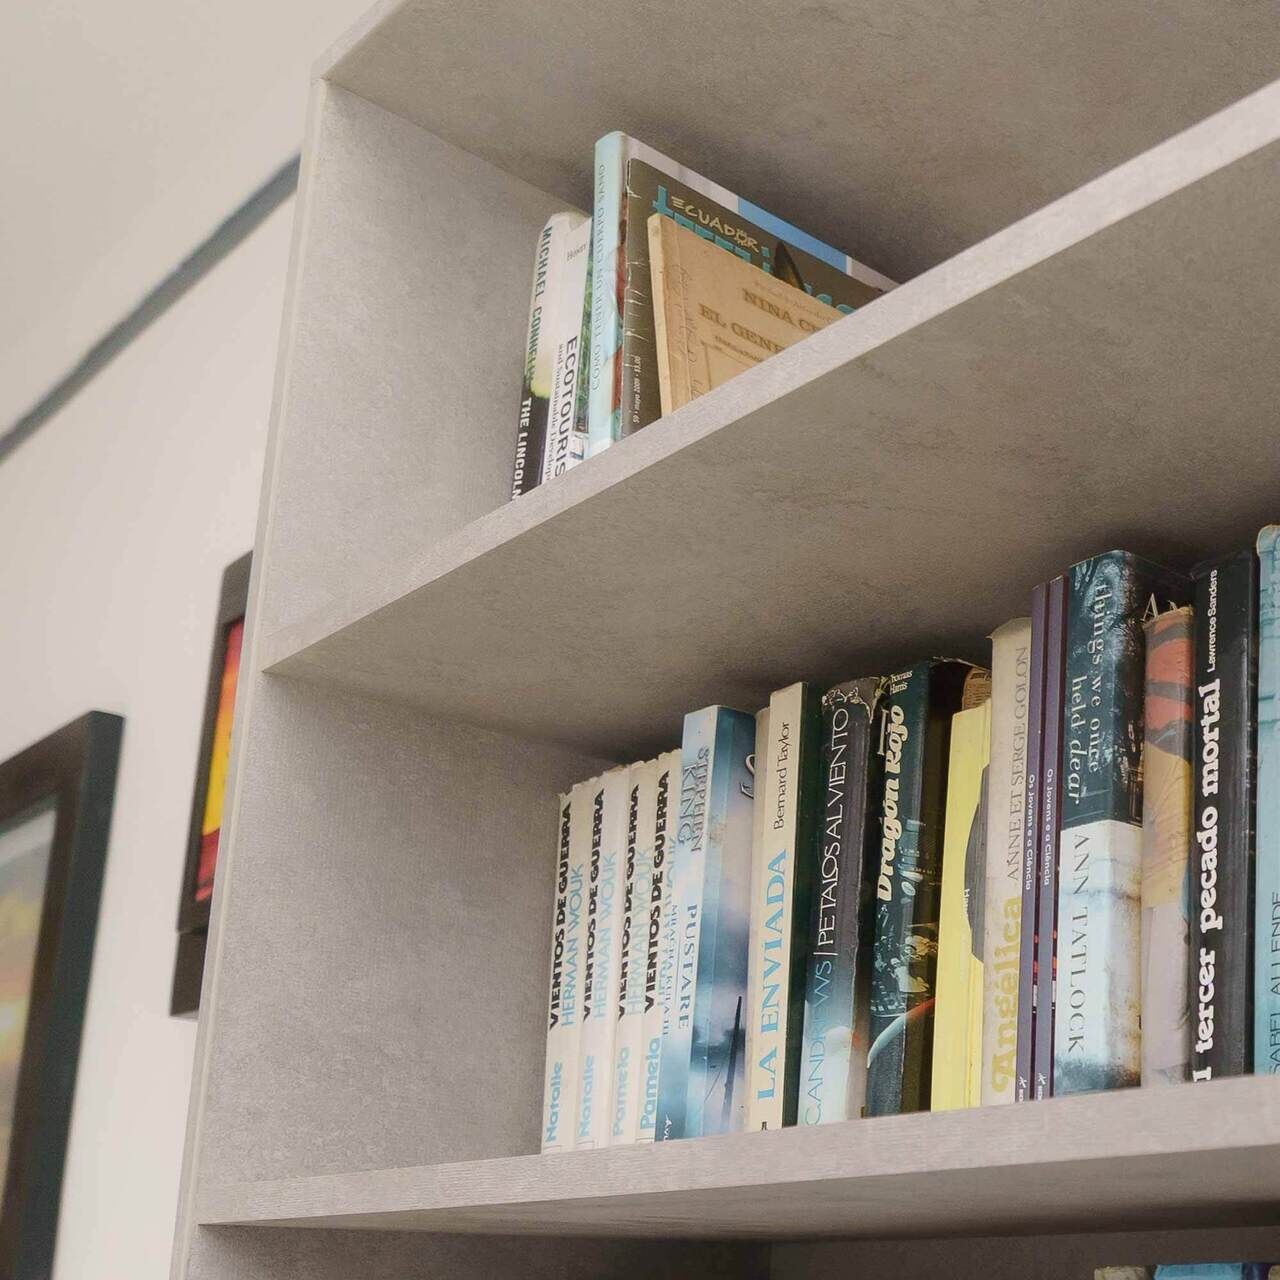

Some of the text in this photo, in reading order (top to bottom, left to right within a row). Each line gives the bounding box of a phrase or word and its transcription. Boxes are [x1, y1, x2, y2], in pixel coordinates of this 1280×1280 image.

[518, 398, 532, 430] THE
[1011, 722, 1025, 787] SERGE
[1070, 676, 1088, 729] held
[1089, 675, 1103, 773] we once
[556, 802, 571, 926] DE GUERRA
[1009, 791, 1022, 816] ET
[1195, 569, 1224, 1054] tercer pecado mortal Lawrence Sanders
[583, 788, 605, 1023] VIENTOS DE GUERRA
[617, 784, 640, 1023] VIENTOS DE GUERRA
[645, 770, 670, 1014] VIENTOS DE GUERRA
[761, 848, 788, 1034] ENVIADA
[1067, 834, 1090, 1055] ANN TATLOCK
[679, 904, 698, 1030] PUSTARE
[757, 1047, 777, 1100] LA
